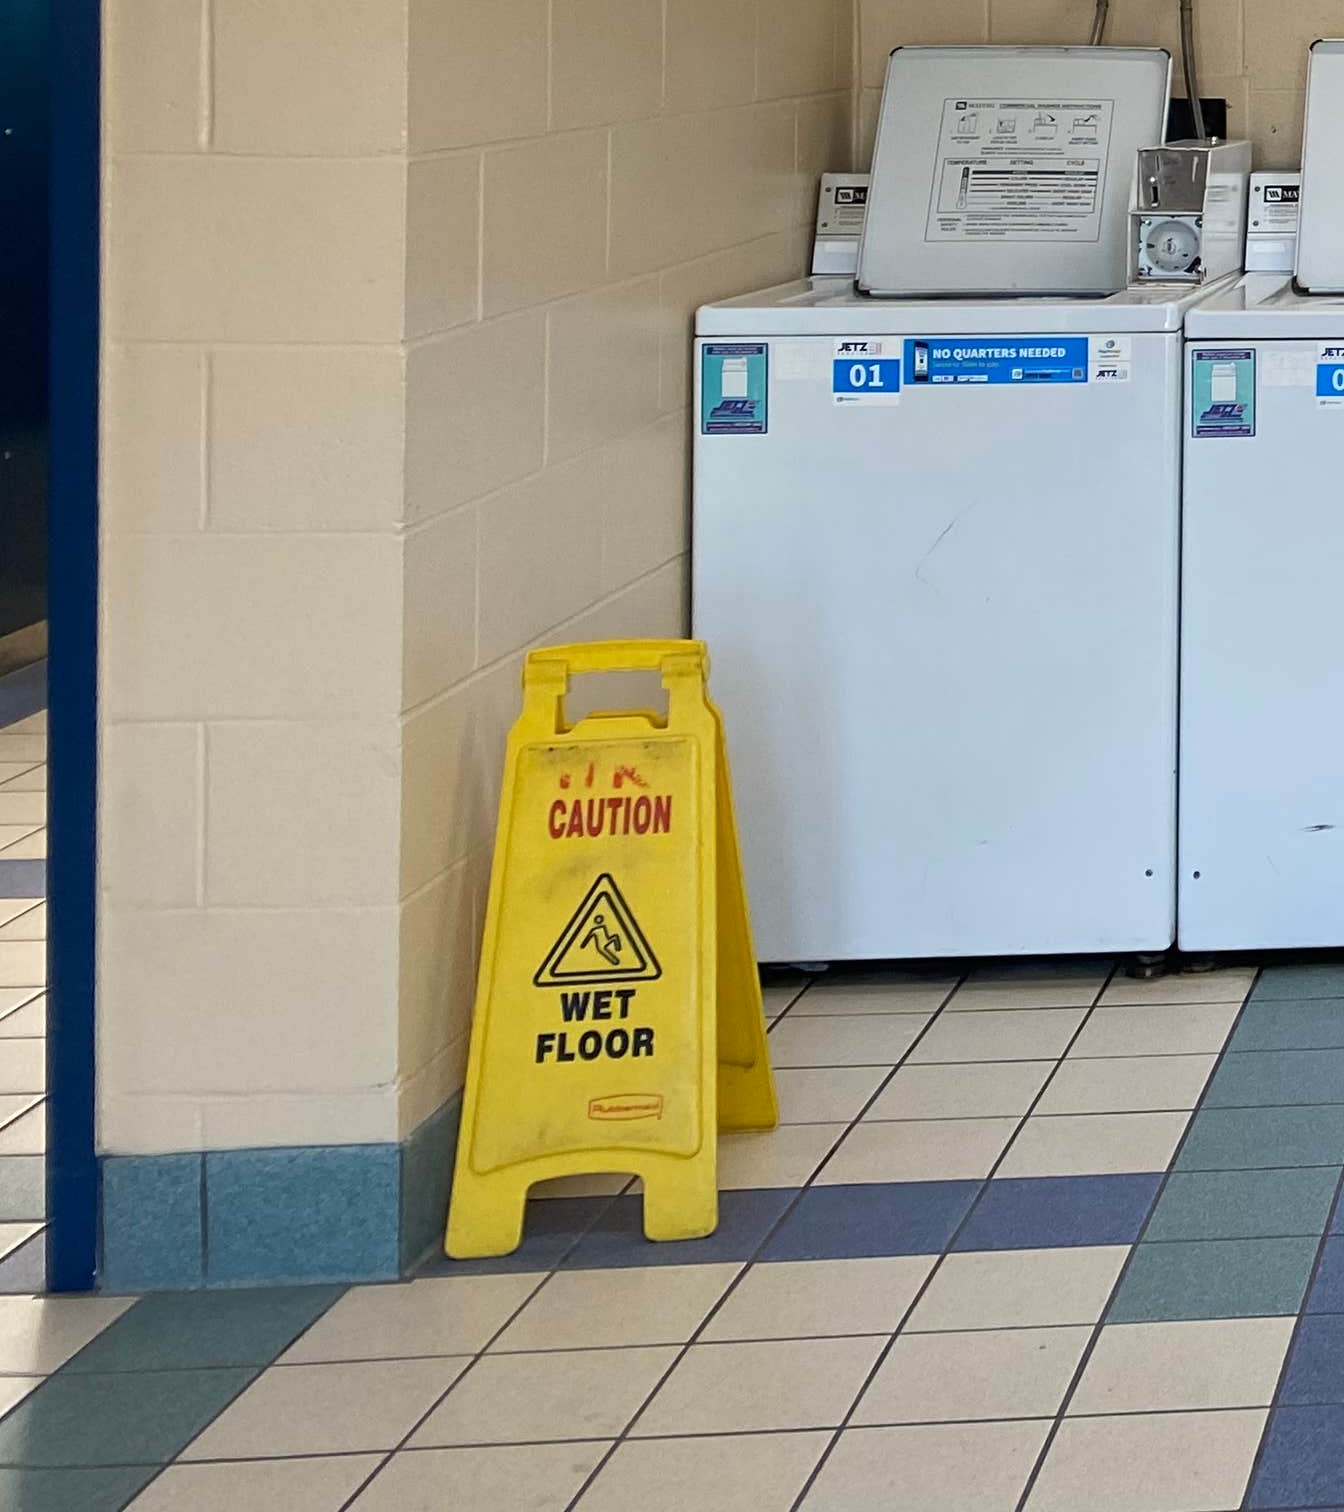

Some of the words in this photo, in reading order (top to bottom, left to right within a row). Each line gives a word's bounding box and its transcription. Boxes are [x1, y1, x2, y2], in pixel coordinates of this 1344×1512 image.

[837, 342, 868, 353] JETZ
[932, 348, 950, 359] NO
[953, 347, 1017, 360] QUARTERS
[1019, 347, 1066, 358] NEEDED
[849, 363, 884, 388] 01
[548, 794, 673, 840] CAUTION
[560, 989, 636, 1022] WET
[535, 1027, 655, 1064] FLOOR
